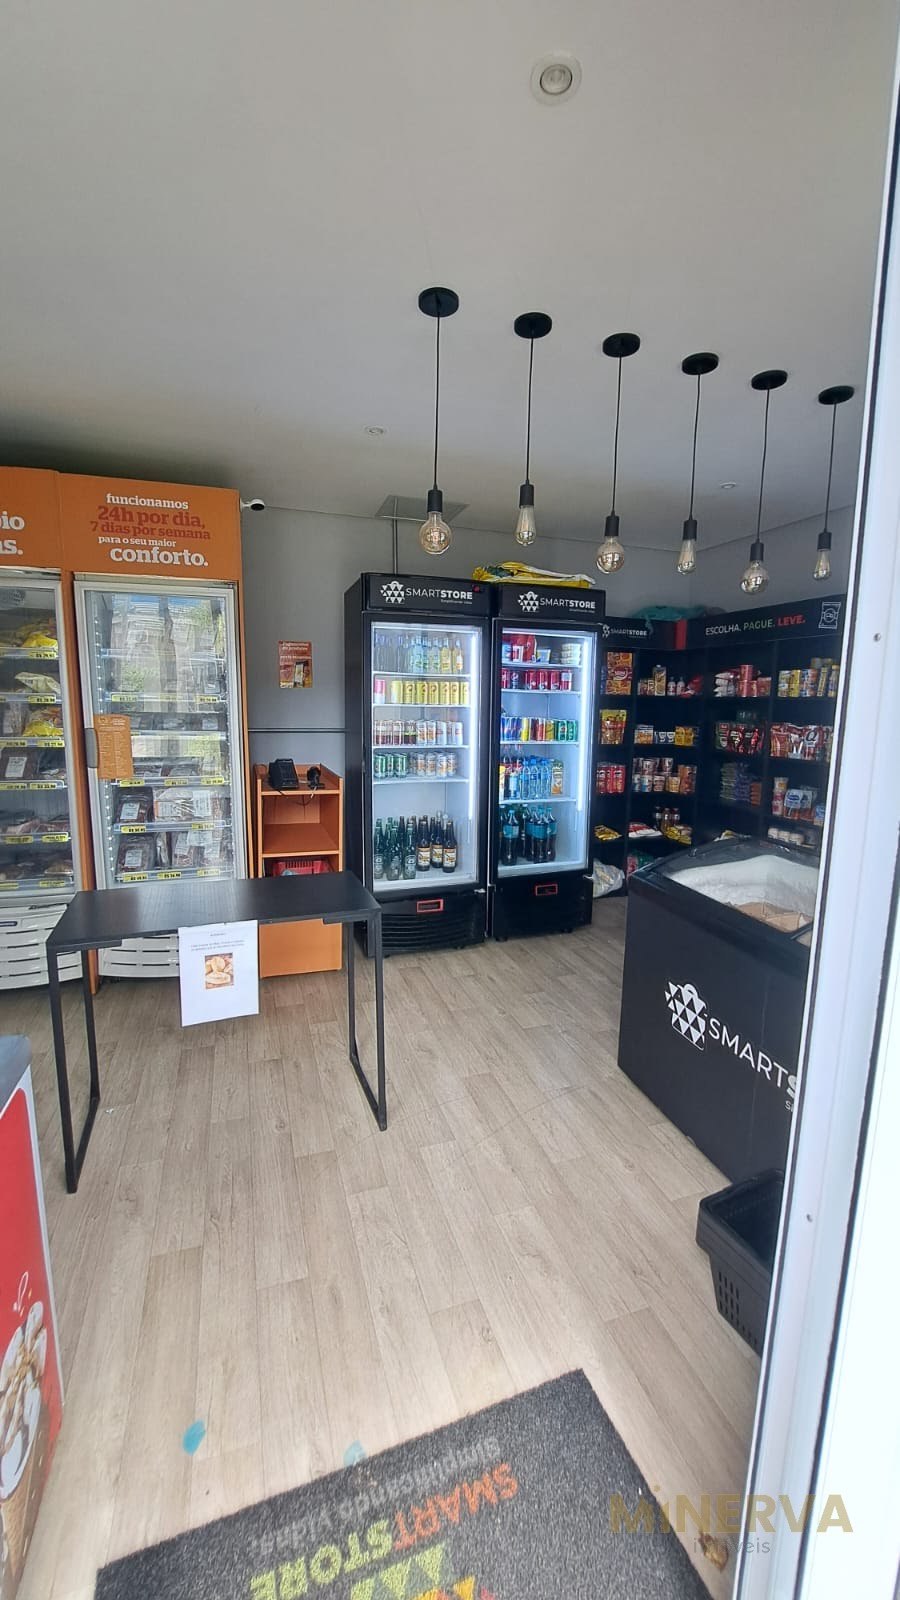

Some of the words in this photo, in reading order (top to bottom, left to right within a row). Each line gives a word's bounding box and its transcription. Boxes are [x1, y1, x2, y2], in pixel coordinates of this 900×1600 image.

[106, 493, 189, 510] funcionamos
[0, 511, 25, 530] io
[98, 506, 135, 522] 24h
[137, 511, 169, 526] por
[172, 511, 205, 529] dia,
[90, 521, 98, 532] 7
[101, 521, 130, 534] dias
[132, 525, 158, 537] por
[158, 528, 211, 540] semana
[0, 539, 24, 556] s.
[98, 536, 121, 544] para
[148, 538, 177, 547] maior
[110, 546, 209, 567] conforto.
[405, 587, 473, 600] SMARTSTORE
[540, 597, 596, 609] SMARTSTORE
[705, 623, 741, 636] ESCOLHA.
[743, 619, 775, 631] PAGUE.
[778, 615, 806, 626] LEVE.
[250, 1463, 518, 1600] SMARTSTORE
